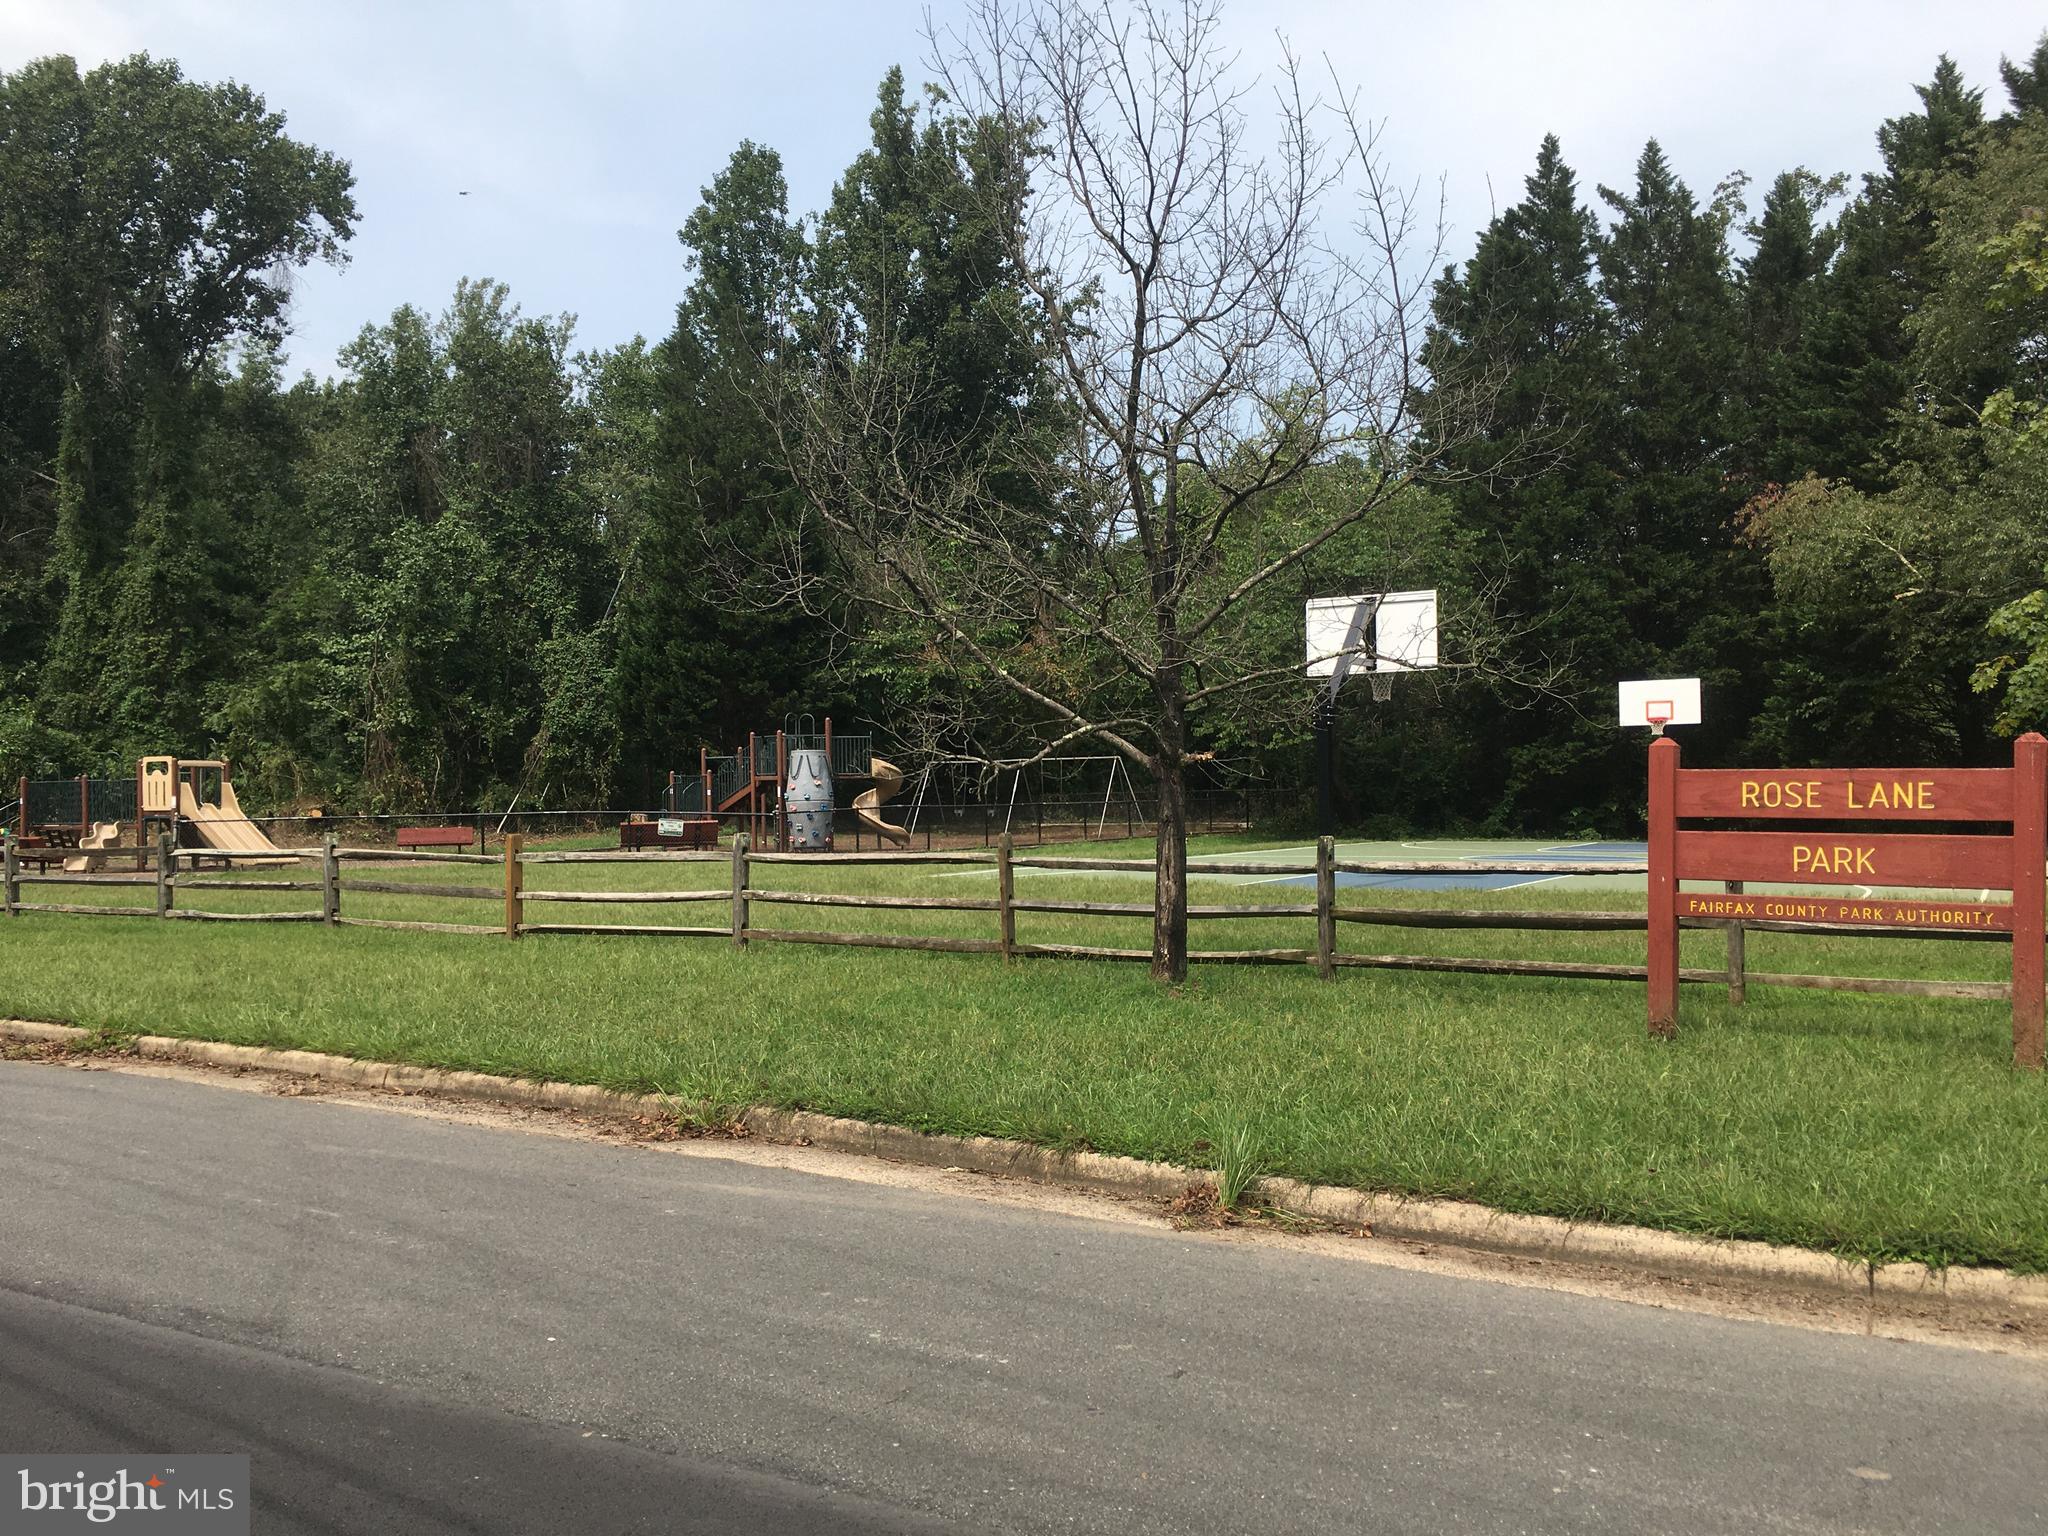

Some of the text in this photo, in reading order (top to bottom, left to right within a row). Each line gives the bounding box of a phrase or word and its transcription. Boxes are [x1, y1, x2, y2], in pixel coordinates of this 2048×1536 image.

[1741, 781, 1935, 809] ROSE LANE
[1793, 846, 1876, 874] PARK
[1690, 900, 1994, 925] FAIRFAX COUNTY PARK AUTHORITY
